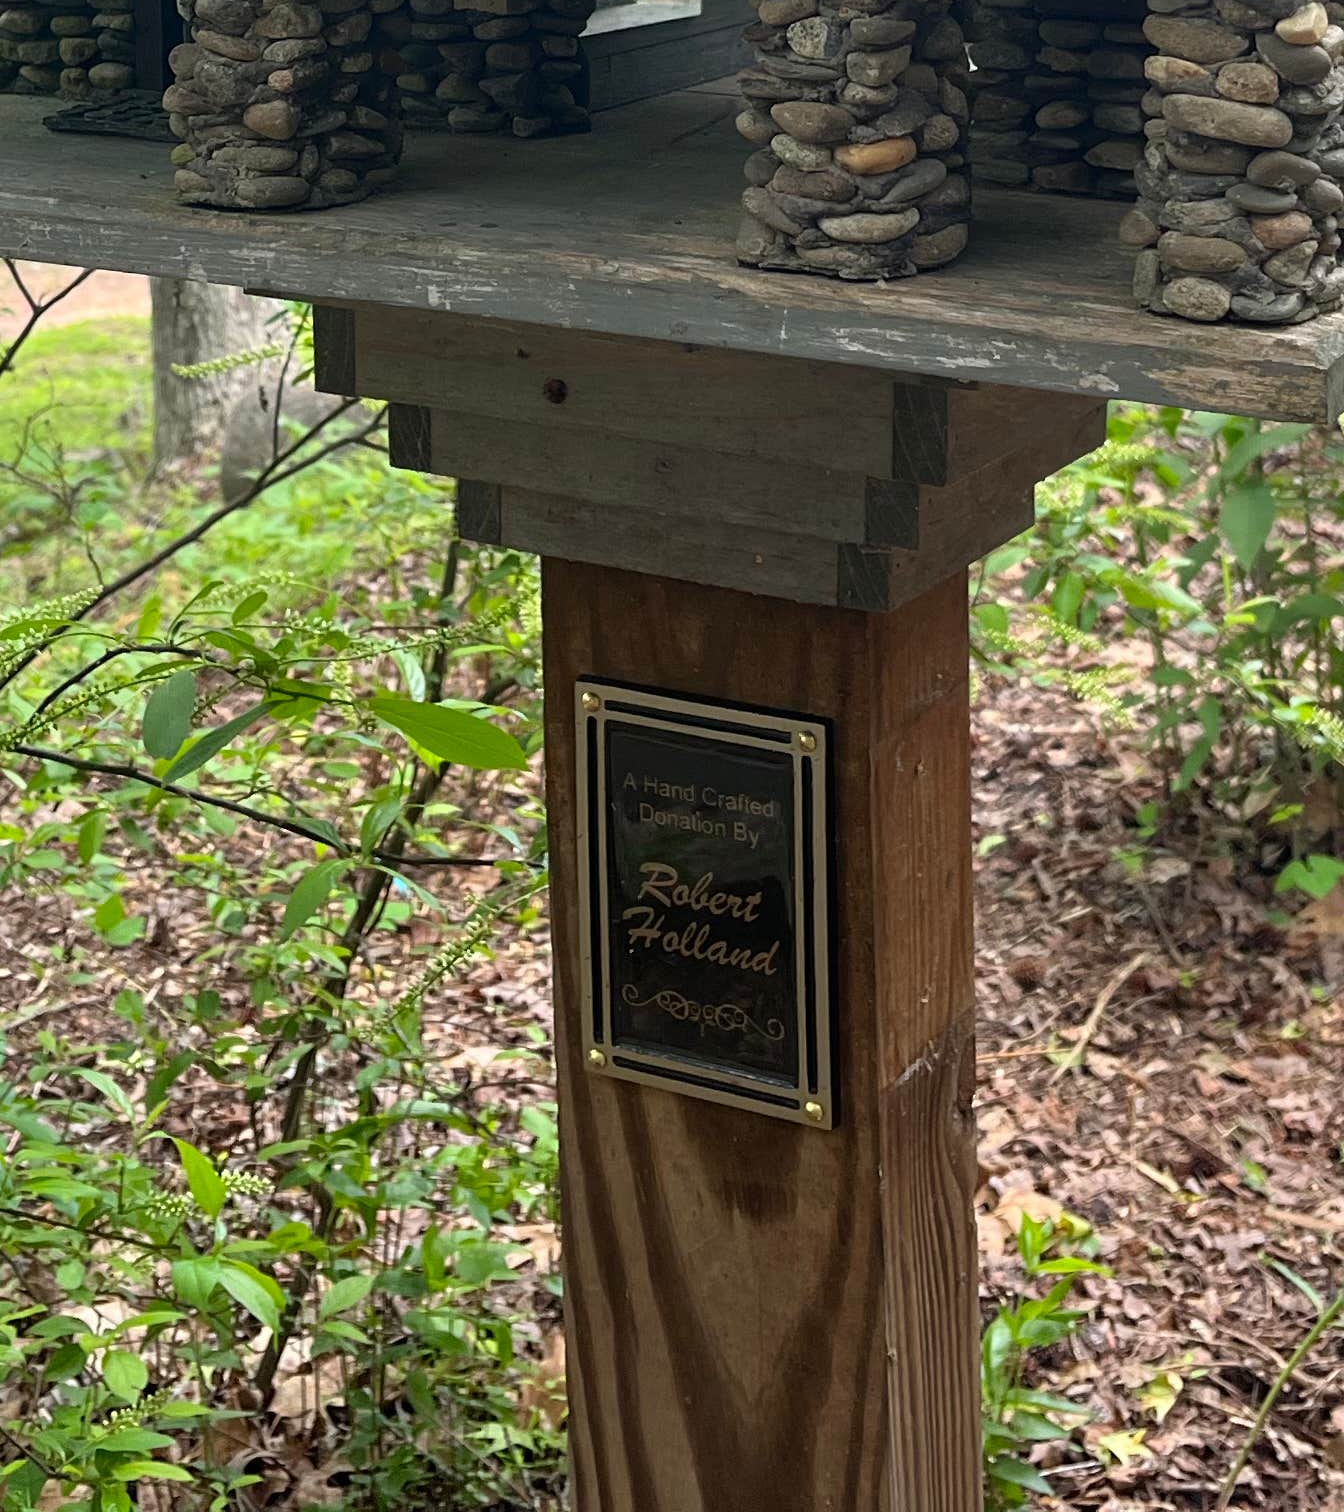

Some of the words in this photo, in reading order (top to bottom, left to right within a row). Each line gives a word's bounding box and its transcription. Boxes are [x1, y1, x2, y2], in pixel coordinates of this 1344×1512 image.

[623, 772, 638, 792] A
[643, 777, 695, 804] Hand
[703, 788, 775, 818] Crafted
[639, 803, 726, 838] Donation
[733, 822, 760, 848] By
[637, 862, 763, 923] Robert
[622, 906, 781, 976] Holland
